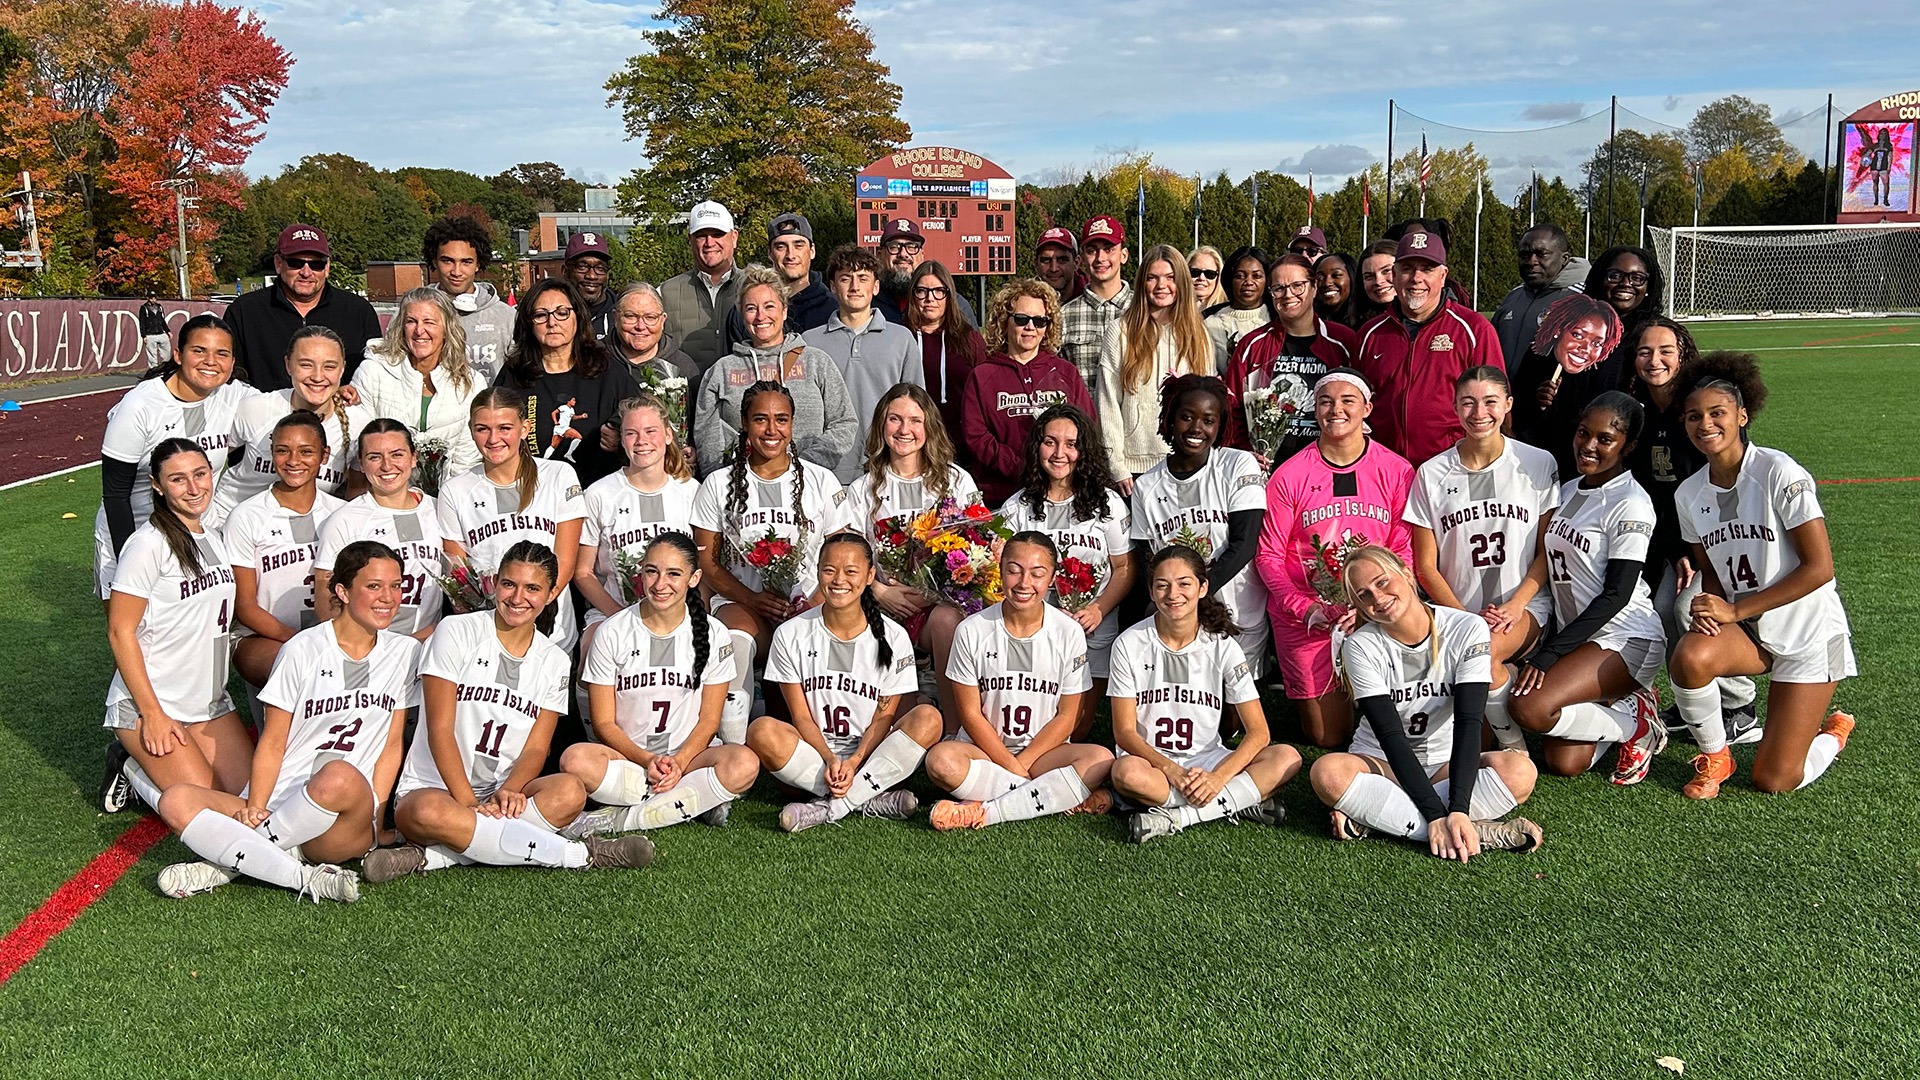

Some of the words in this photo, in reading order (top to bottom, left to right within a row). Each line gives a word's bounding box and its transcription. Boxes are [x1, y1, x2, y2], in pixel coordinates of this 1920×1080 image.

[1880, 92, 1920, 111] RHOD
[891, 148, 936, 169] RHODE
[938, 147, 983, 170] ISLAND
[911, 164, 965, 178] COLLEGE
[912, 184, 929, 192] GIL'S
[930, 185, 971, 193] APPLIANCES
[871, 201, 887, 210] RIC
[922, 221, 945, 230] PERIOD
[863, 235, 882, 243] PLAYE
[961, 235, 982, 243] PLAYER
[988, 235, 1011, 243] PENALTY
[731, 373, 746, 384] RIC
[1273, 361, 1299, 373] CCER
[528, 433, 540, 455] LEAH
[738, 512, 766, 530] HODE
[1190, 508, 1229, 525] ISLAN
[1302, 502, 1342, 529] RHODE
[1344, 498, 1390, 524] ISLAND
[1440, 505, 1480, 534] RHODE
[1482, 501, 1529, 524] ISLAND
[468, 522, 507, 547] RHODE
[510, 513, 556, 537] ISLAND
[611, 529, 649, 549] RHODE
[1058, 531, 1101, 551] ISLAND
[1555, 519, 1591, 554] ISLAND
[1699, 527, 1728, 550] HODE
[1728, 521, 1775, 542] ISLAND
[262, 549, 305, 574] RHODE
[412, 542, 440, 562] ISLA
[1469, 531, 1507, 568] 23
[1548, 549, 1572, 581] 17
[1726, 554, 1759, 591] 14
[180, 570, 218, 601] RHODE
[402, 573, 426, 606] 21
[217, 598, 228, 633] 4
[617, 671, 657, 692] RHODE
[804, 676, 833, 694] HODE
[837, 673, 881, 701] ISLAN
[1017, 672, 1059, 697] ISLAND
[304, 692, 350, 719] RHODE
[355, 689, 396, 713] ISLAND
[456, 683, 501, 704] RHODE
[503, 688, 542, 719] ISLAN
[1174, 685, 1220, 710] ISLAND
[652, 701, 670, 733] 7
[822, 704, 850, 737] 16
[1002, 705, 1032, 737] 19
[315, 717, 363, 752] 22
[475, 719, 508, 757] 11
[1154, 717, 1194, 750] 29
